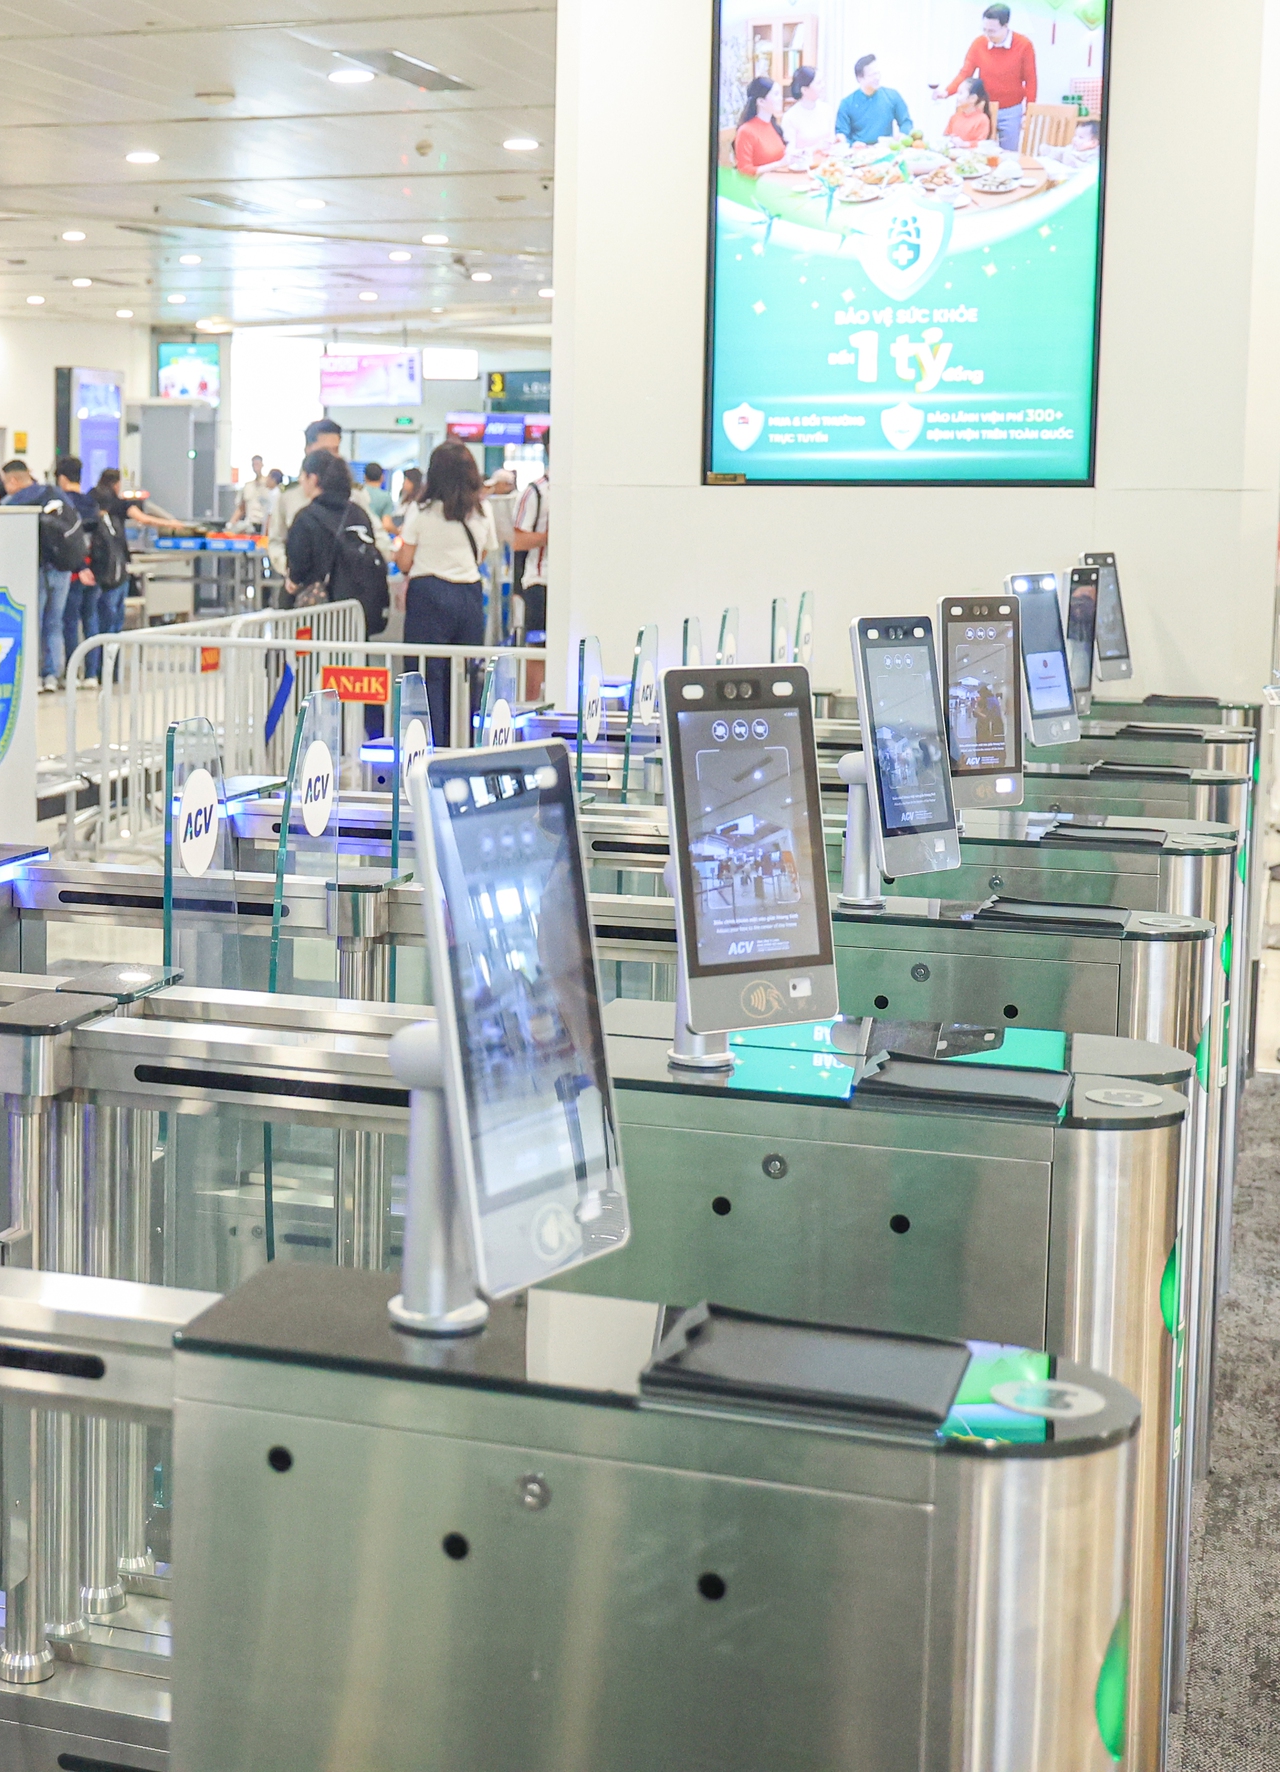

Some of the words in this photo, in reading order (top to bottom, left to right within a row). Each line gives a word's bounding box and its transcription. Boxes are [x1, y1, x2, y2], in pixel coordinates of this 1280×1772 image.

[835, 307, 870, 325] BẢO
[872, 308, 893, 327] VỆ
[896, 307, 930, 324] SỨC
[933, 304, 979, 323] KHỎE
[848, 330, 879, 382] 1
[890, 326, 953, 393] tỷ
[491, 373, 503, 392] 3
[1025, 408, 1063, 422] 300+
[493, 726, 510, 747] ACV
[304, 773, 330, 805] ACV
[183, 804, 214, 843] ACV
[728, 940, 754, 956] ACV
